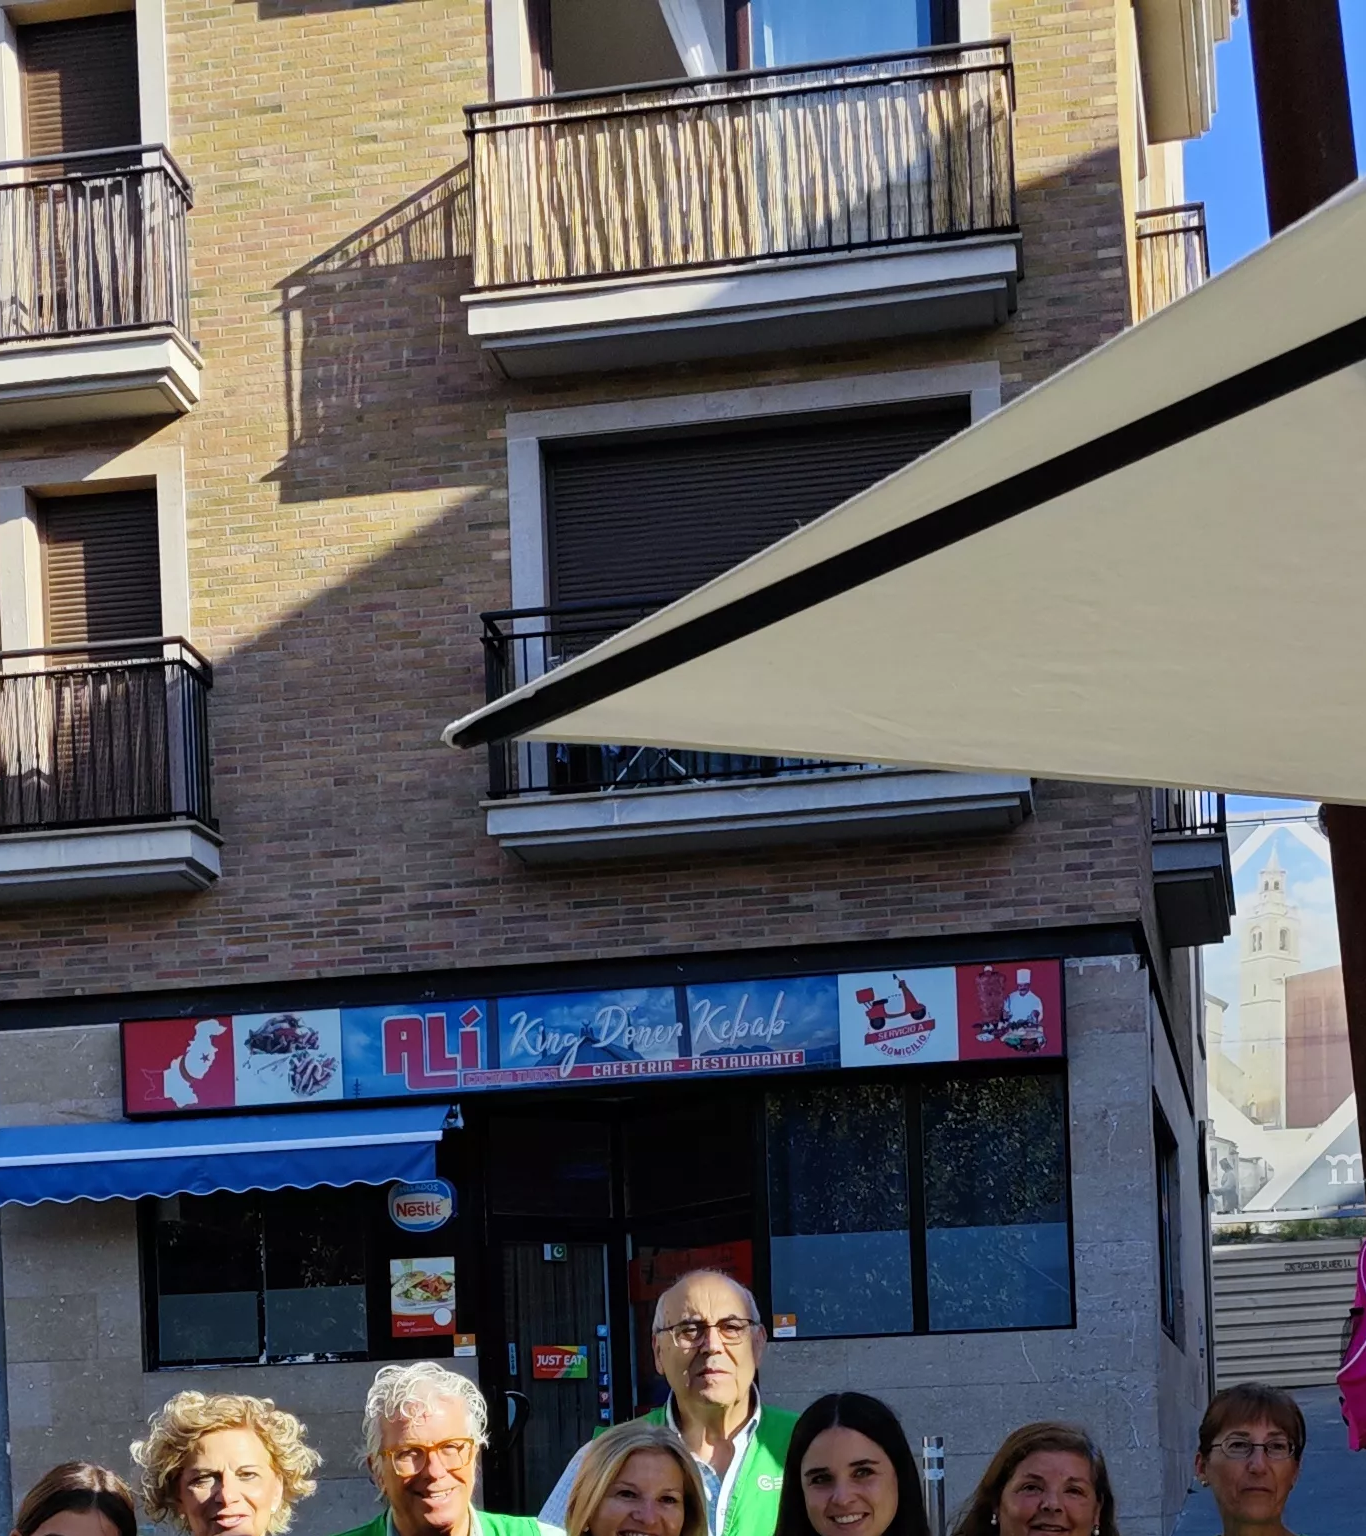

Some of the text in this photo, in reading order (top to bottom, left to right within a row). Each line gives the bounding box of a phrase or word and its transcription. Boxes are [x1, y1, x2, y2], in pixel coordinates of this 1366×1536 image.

[509, 1011, 588, 1078] King
[691, 990, 791, 1044] Kebab
[877, 1025, 916, 1041] SERVICIO
[880, 1034, 927, 1056] DOMICILIO
[592, 1059, 674, 1077] CAFETERIA
[691, 1051, 802, 1071] RESTAURANTE
[536, 1354, 562, 1368] JUST
[563, 1354, 585, 1367] EAT
